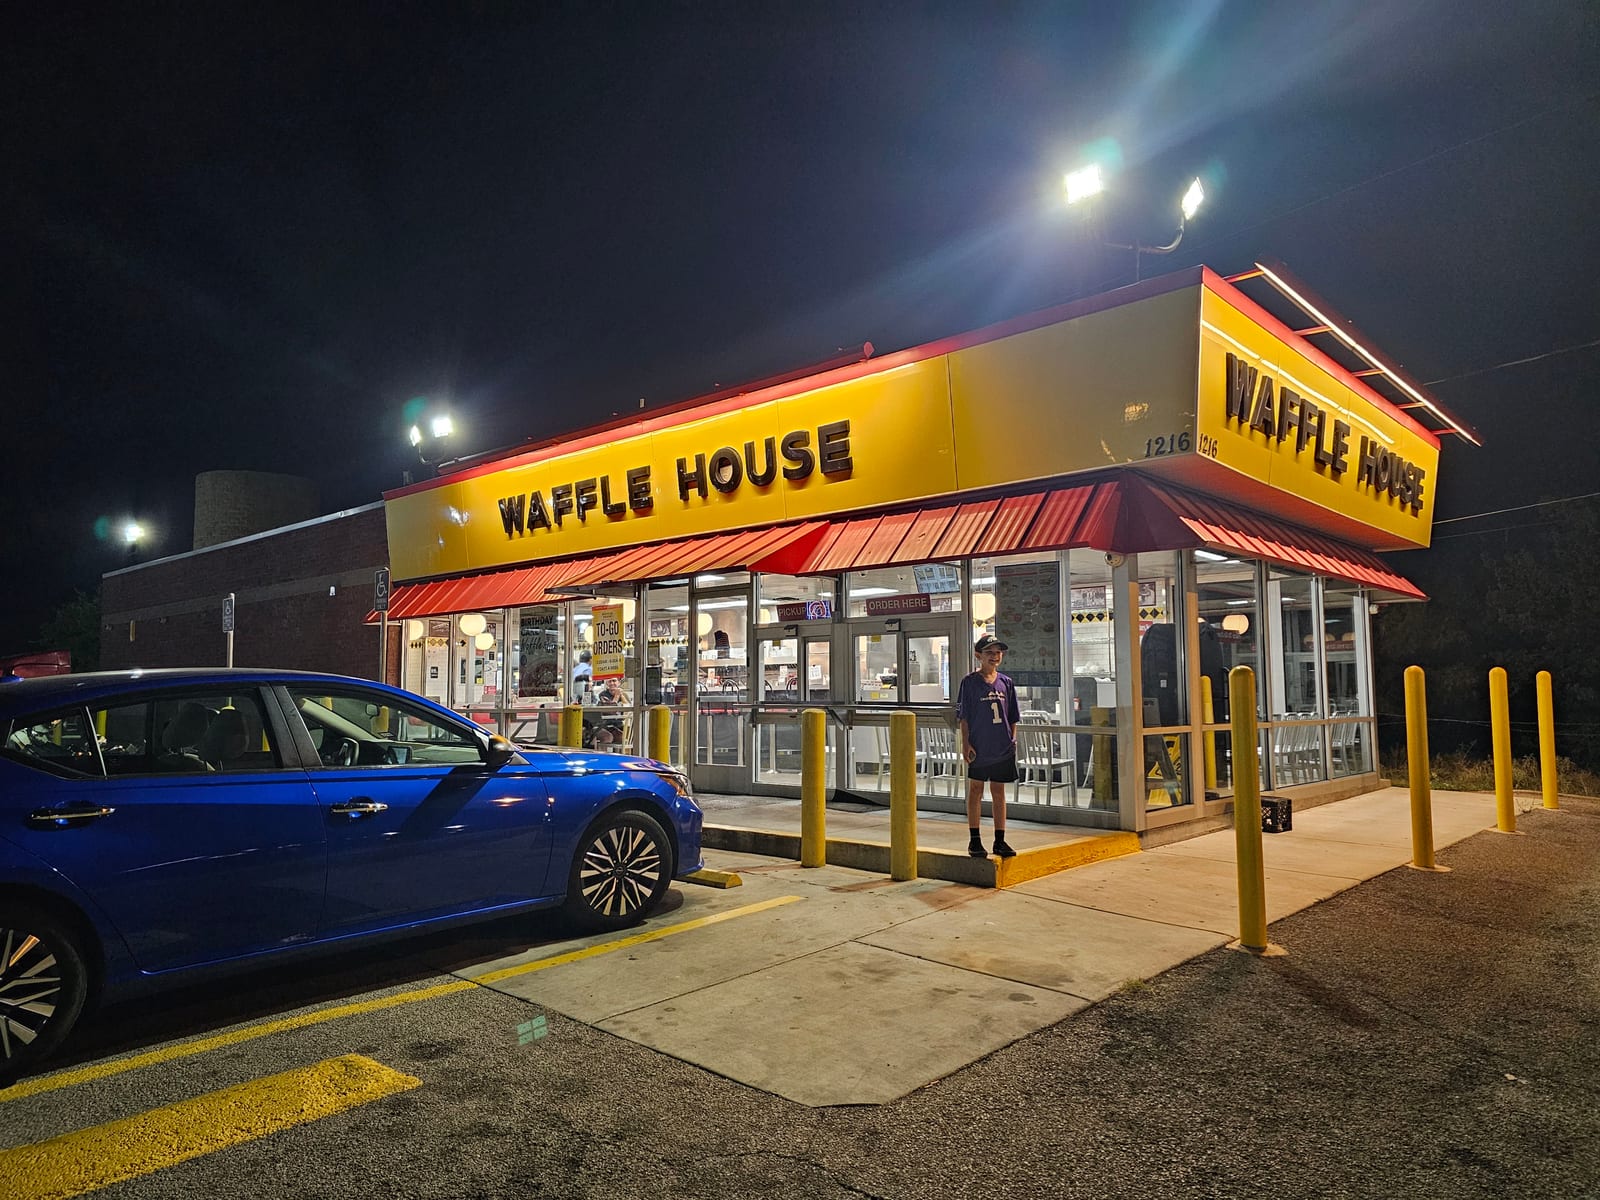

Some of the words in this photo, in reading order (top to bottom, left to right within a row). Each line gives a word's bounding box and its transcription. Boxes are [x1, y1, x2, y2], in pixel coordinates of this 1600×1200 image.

[1226, 352, 1350, 474] WAFFLE
[1358, 435, 1426, 511] HOUSE
[1144, 431, 1191, 458] 1216
[1198, 432, 1218, 459] 1216
[498, 465, 654, 535] WAFFLE
[676, 419, 854, 501] HOUSE
[778, 606, 807, 617] PICKUP
[868, 599, 901, 611] ORDER
[902, 597, 928, 609] HERE
[596, 620, 619, 637] TO-GO
[593, 639, 623, 656] ORDERS
[990, 702, 1002, 724] 1
